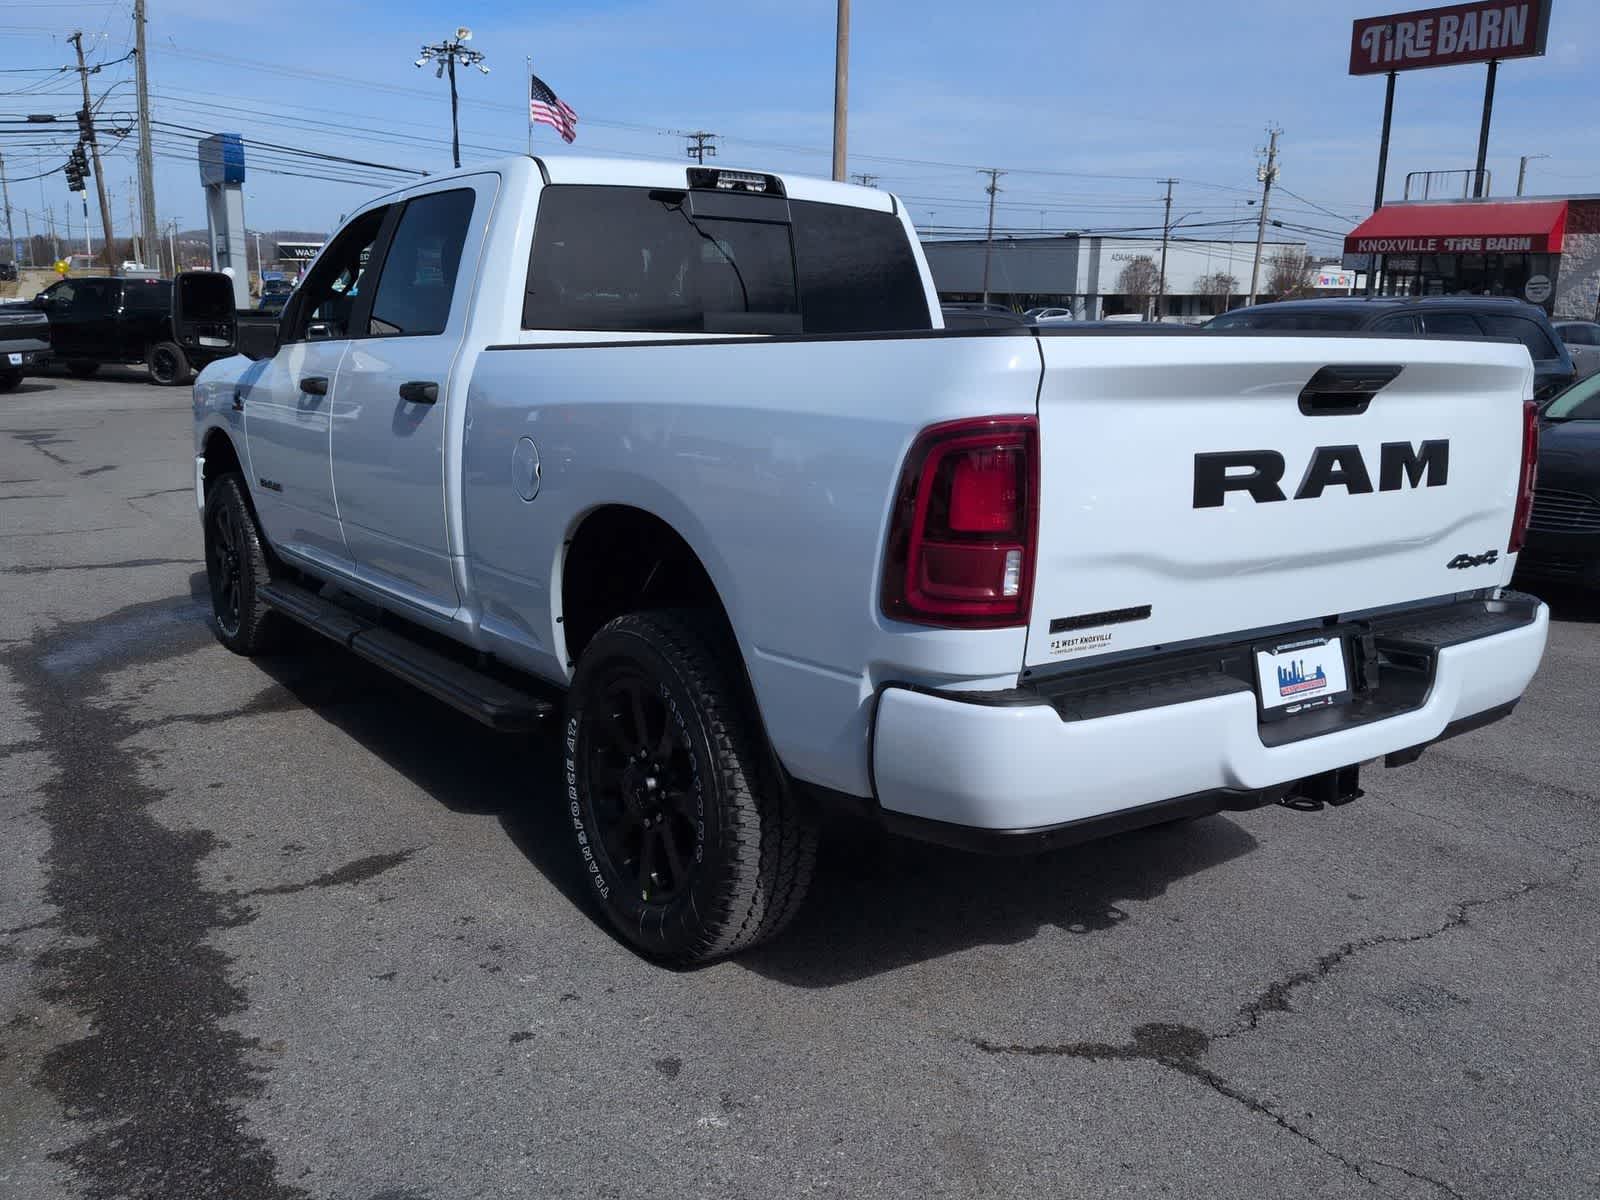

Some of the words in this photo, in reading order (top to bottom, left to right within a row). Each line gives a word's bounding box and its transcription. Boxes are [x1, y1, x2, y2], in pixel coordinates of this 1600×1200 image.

[1436, 4, 1529, 55] BARN
[1358, 239, 1437, 252] KNOXVILLE
[1486, 237, 1531, 250] BARN
[1193, 439, 1449, 508] RAM
[1061, 638, 1079, 647] WEST
[1079, 632, 1113, 644] KNOXVILLE
